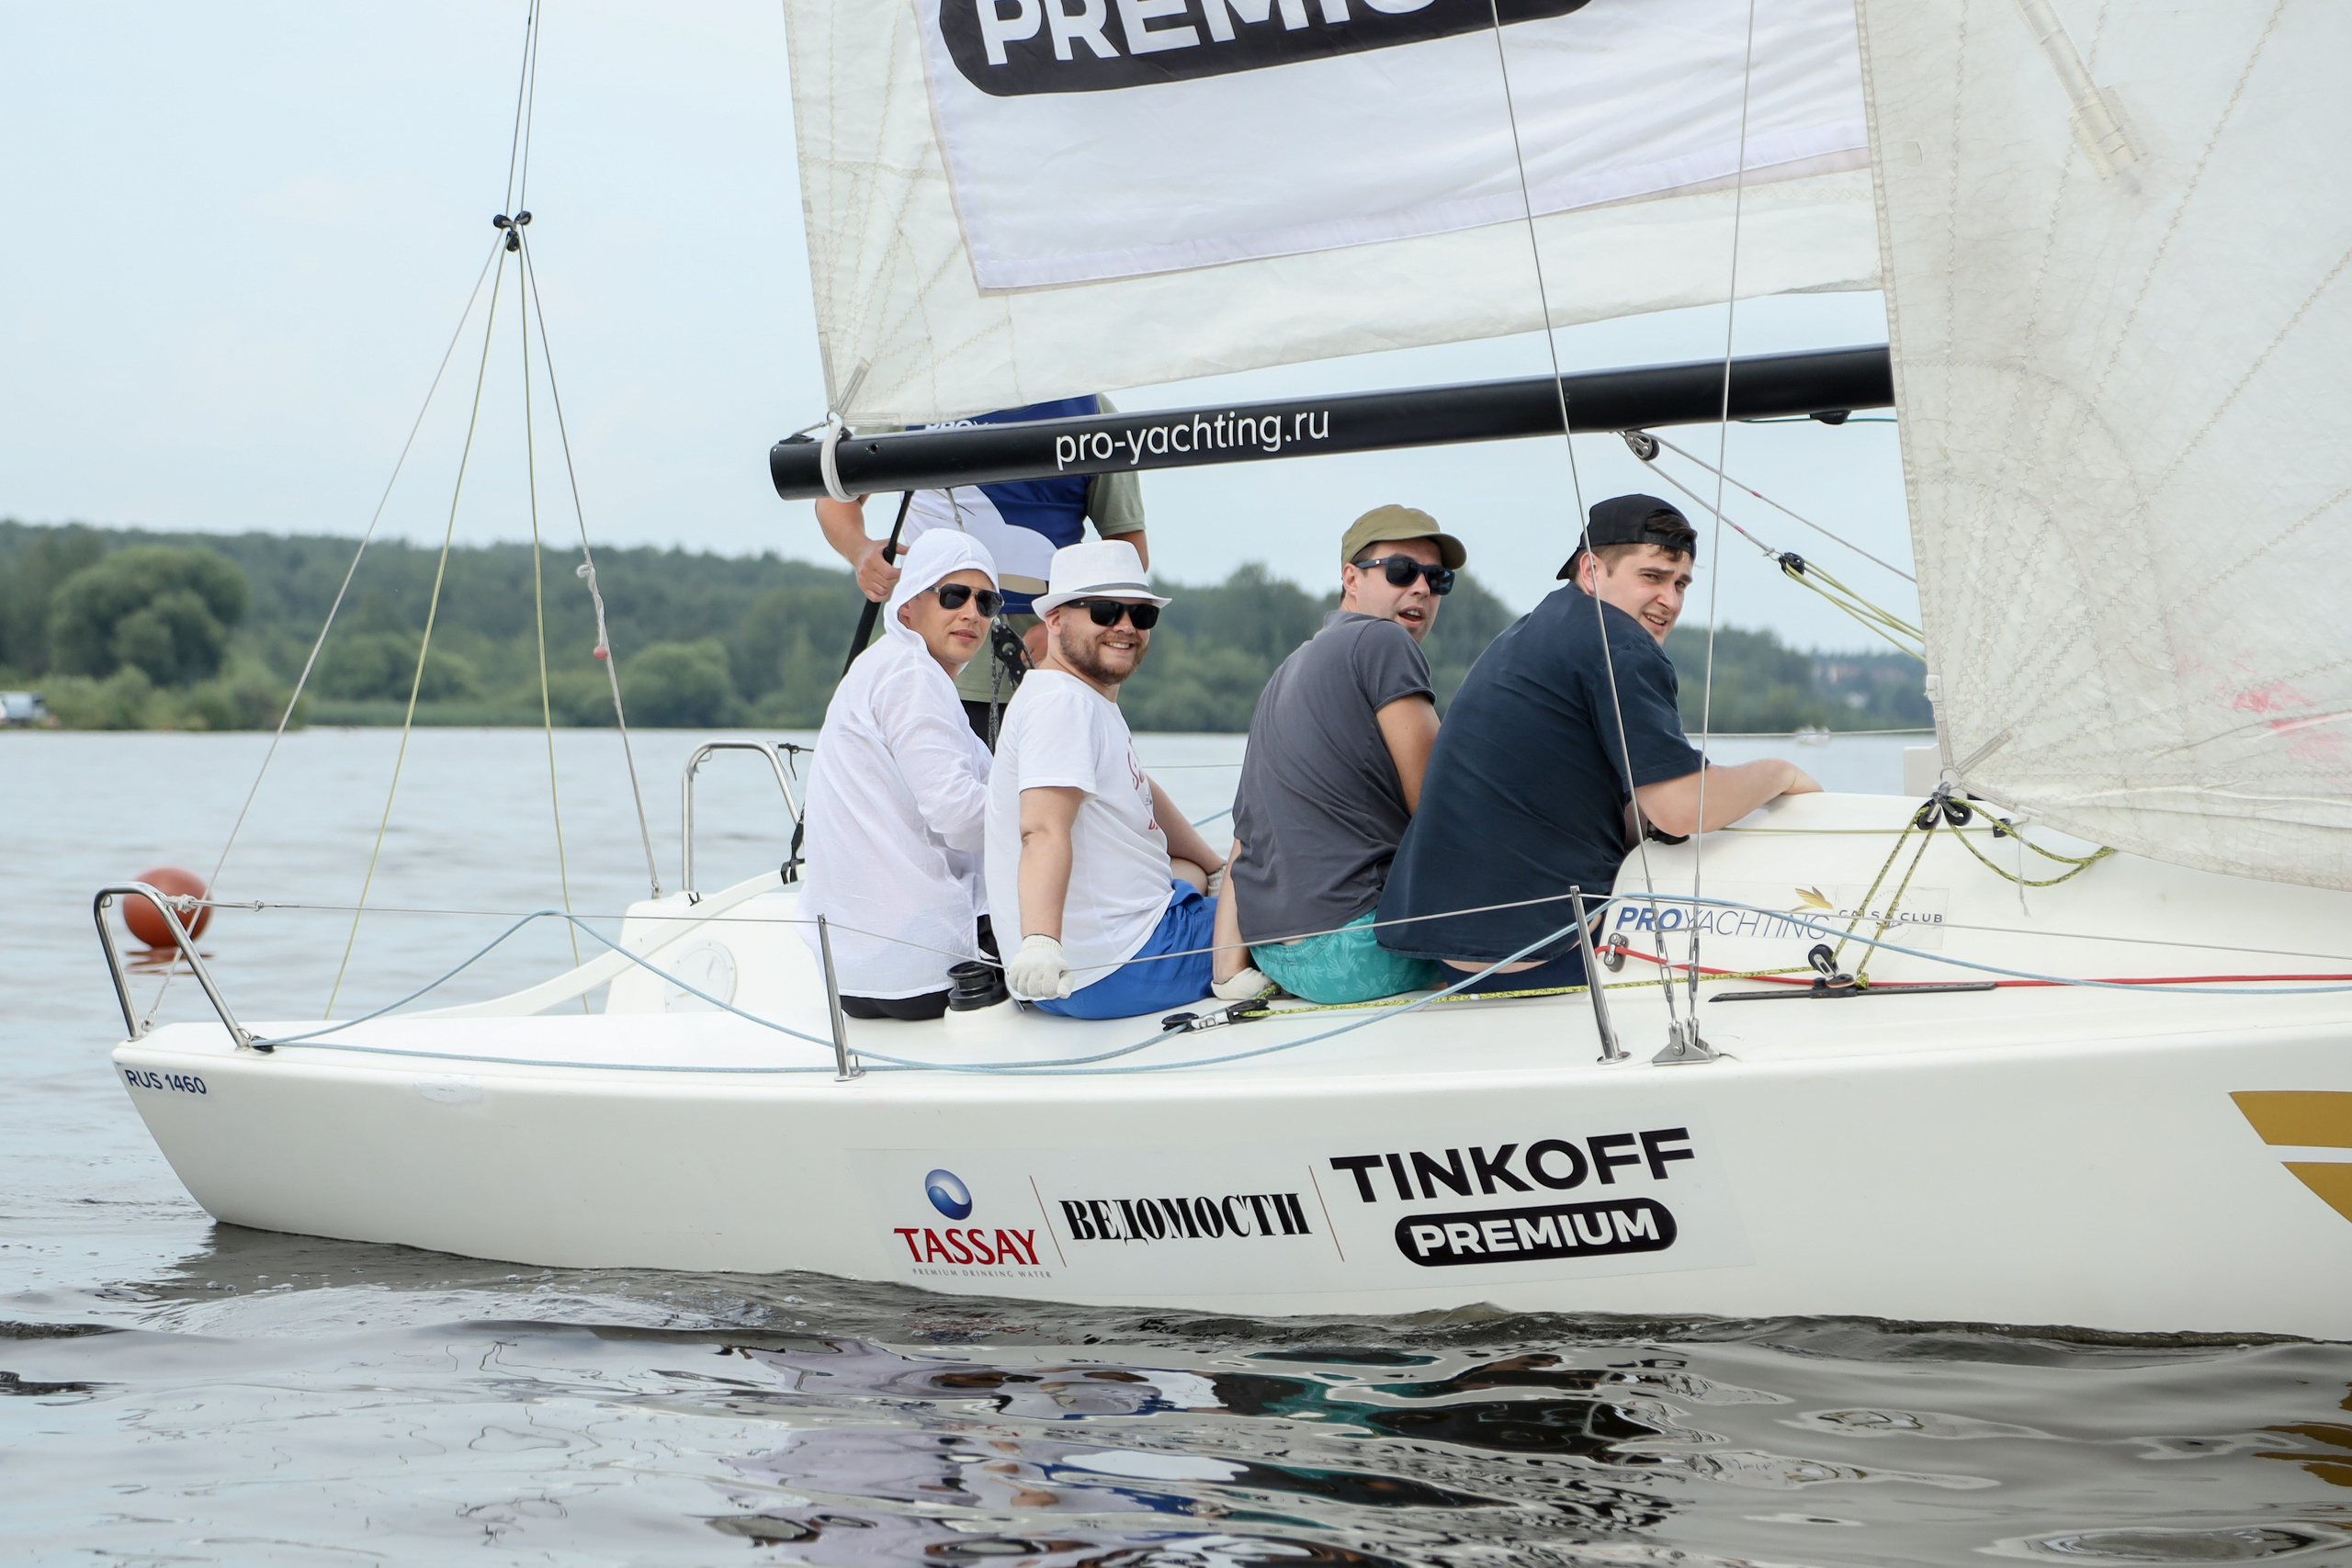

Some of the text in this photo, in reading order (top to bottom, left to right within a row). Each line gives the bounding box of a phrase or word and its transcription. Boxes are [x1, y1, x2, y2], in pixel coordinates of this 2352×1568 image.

[976, 0, 1436, 65] PRE
[1057, 411, 1329, 471] pro-yachting.ru
[1899, 912, 1943, 923] CLUB
[124, 1069, 208, 1095] RUS 1460
[1329, 1127, 1696, 1203] TINKOFF
[1058, 1193, 1313, 1246] ВЕДОМОСТИ
[1408, 1207, 1661, 1258] PREMIUM
[893, 1228, 1041, 1265] TASSAY
[912, 1268, 1053, 1279] PREMIUM DRINKING WATER
